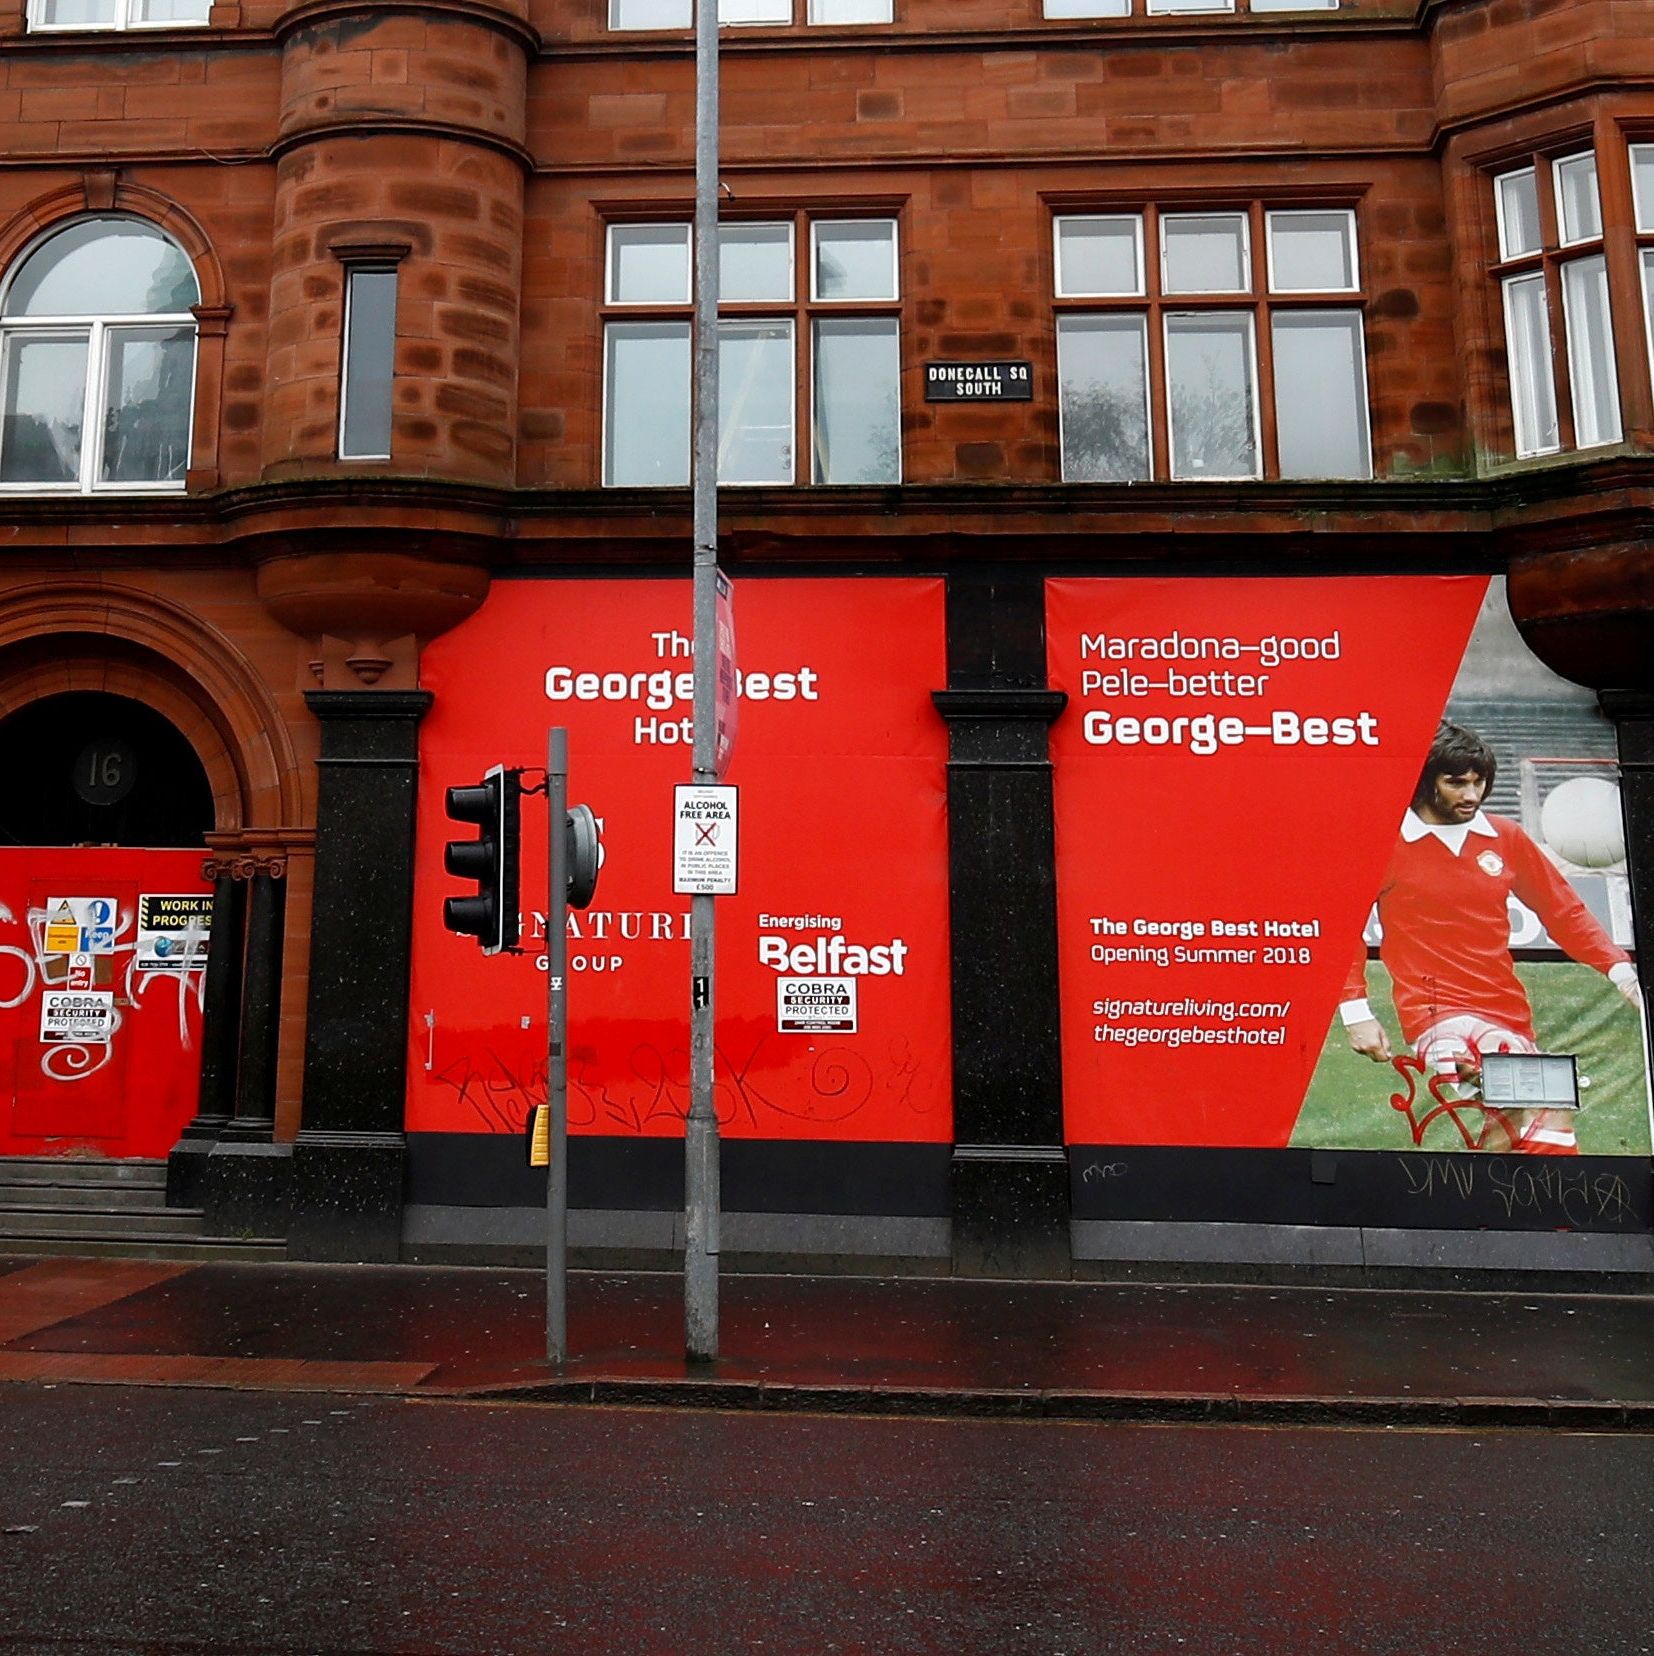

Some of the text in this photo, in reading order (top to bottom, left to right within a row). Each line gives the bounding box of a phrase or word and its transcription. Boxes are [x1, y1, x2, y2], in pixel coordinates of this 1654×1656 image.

[928, 366, 1028, 381] DONEGALL SQ
[956, 381, 1002, 396] SOUTH
[651, 630, 693, 658] Th
[545, 666, 693, 710] George
[634, 716, 693, 744] Hot
[89, 752, 122, 786] 16
[683, 801, 728, 810] ALCOHOL
[680, 810, 731, 819] FREE AREA
[160, 900, 199, 911] WORK
[152, 915, 212, 926] PROGRES
[758, 913, 842, 931] Energising
[1089, 917, 1320, 941] The George Best Hotel
[535, 955, 623, 972] GOUP
[758, 935, 908, 976] Belfast
[1091, 944, 1311, 967] Opening Summer 2018
[785, 983, 848, 995] COBRA
[49, 997, 105, 1008] COBRA
[790, 996, 844, 1005] SECURITY
[53, 1009, 101, 1017] SECURITY
[785, 1006, 849, 1015] PROTECTED
[1092, 997, 1291, 1022] signatureliving.com/
[1094, 1023, 1286, 1048] thegeorgebesthotel
